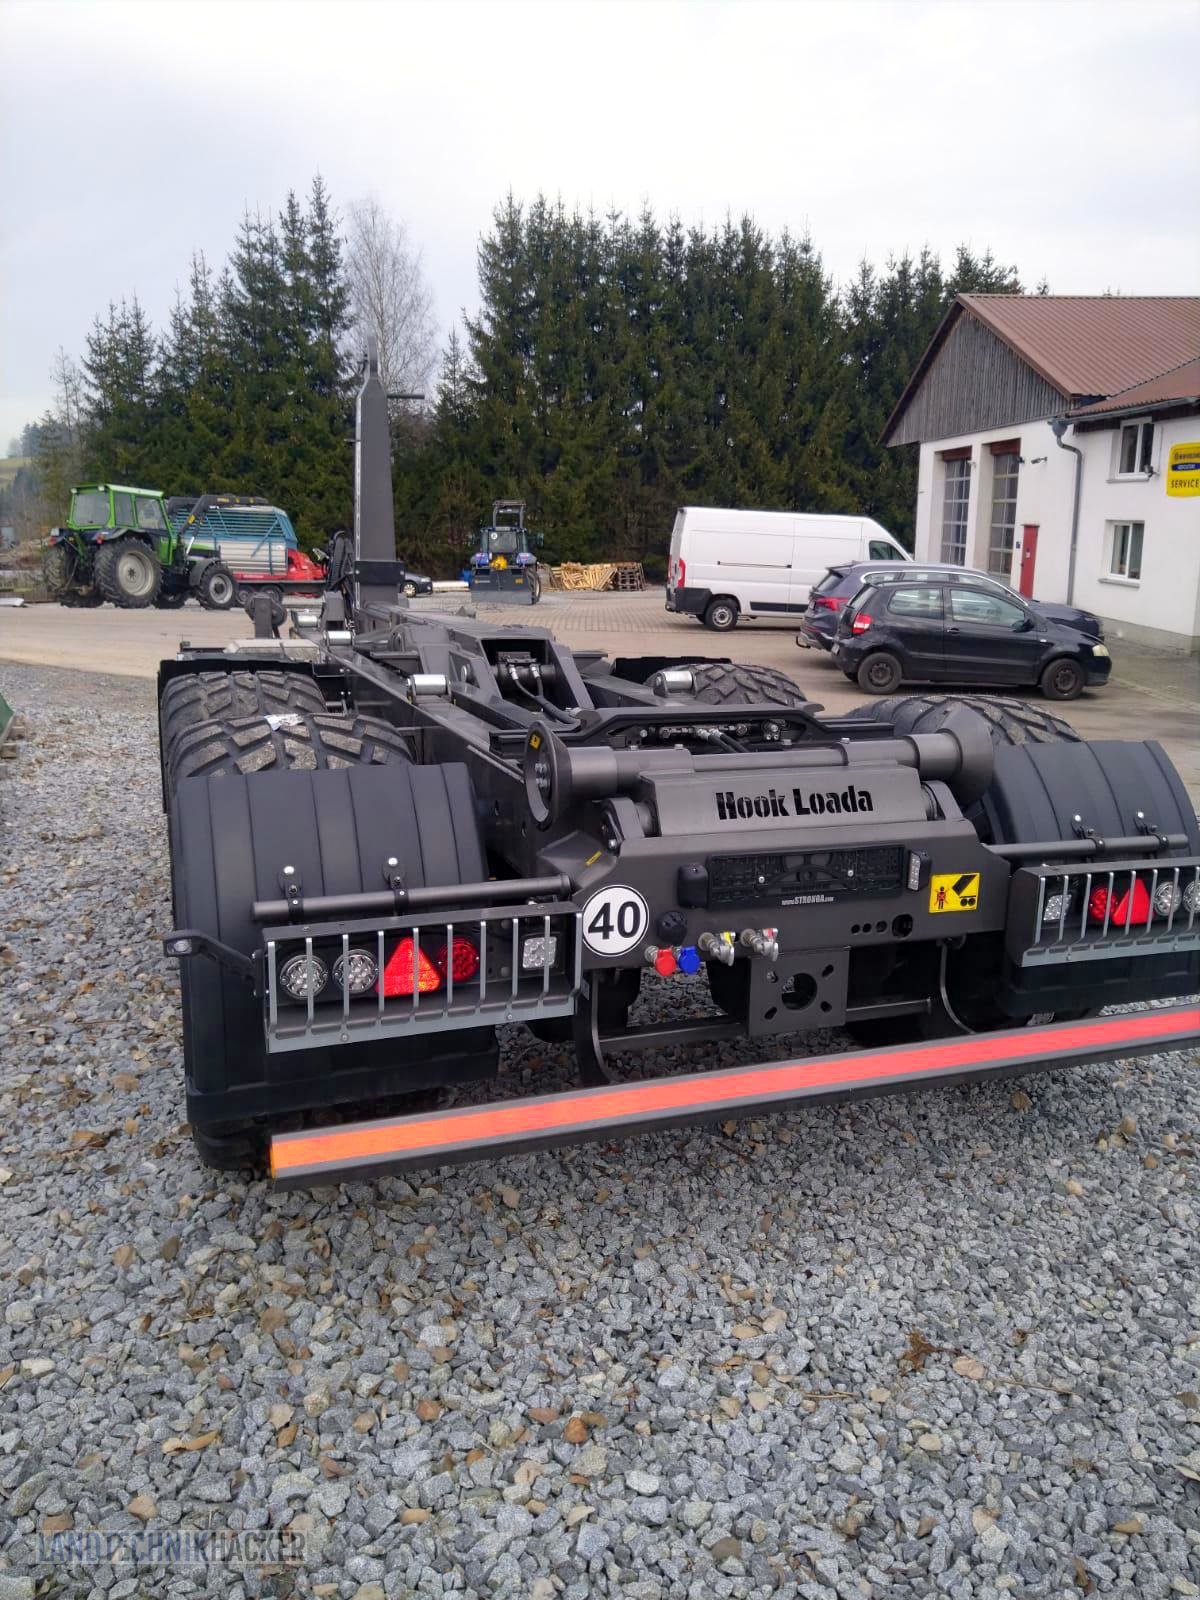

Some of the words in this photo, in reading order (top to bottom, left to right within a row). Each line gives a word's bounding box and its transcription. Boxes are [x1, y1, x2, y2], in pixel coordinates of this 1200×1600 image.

[1171, 479, 1199, 489] SERVICE
[715, 789, 790, 820] Hook
[792, 785, 874, 816] Loada
[588, 901, 641, 940] 40
